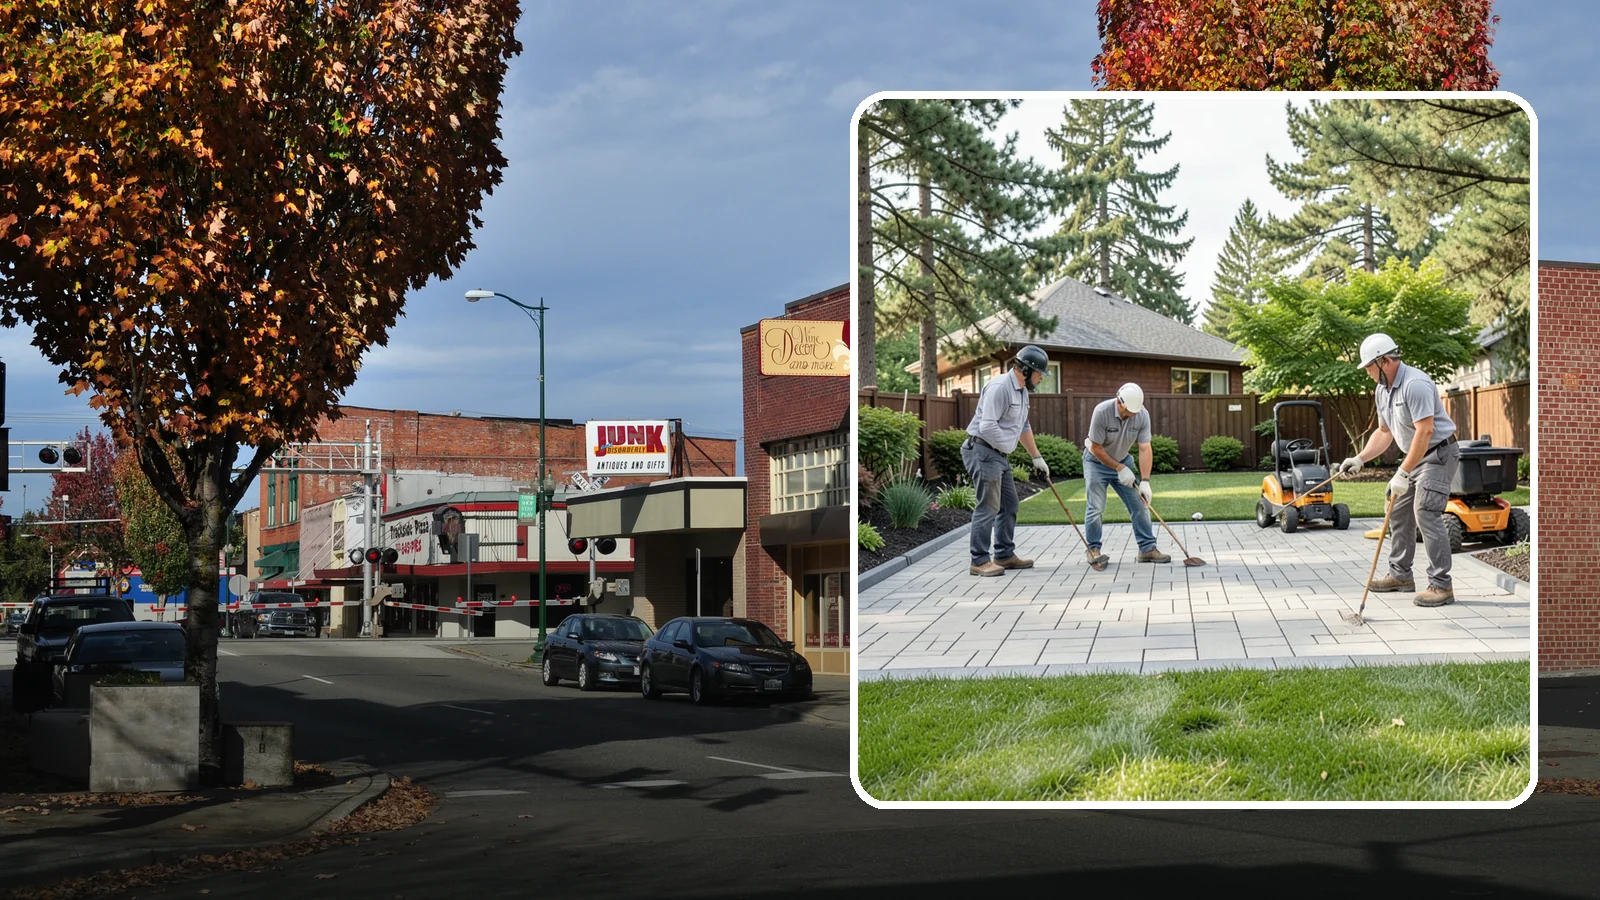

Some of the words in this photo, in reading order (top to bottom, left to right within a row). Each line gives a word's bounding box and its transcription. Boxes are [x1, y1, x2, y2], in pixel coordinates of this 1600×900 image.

[765, 328, 831, 365] Decor
[595, 425, 665, 457] JUNK
[607, 446, 646, 454] DISORDERLY
[597, 461, 628, 470] ANTIQUES
[631, 461, 644, 470] AND
[647, 461, 665, 469] GIFTS
[390, 521, 413, 539] Trackside
[414, 519, 429, 535] Pizza
